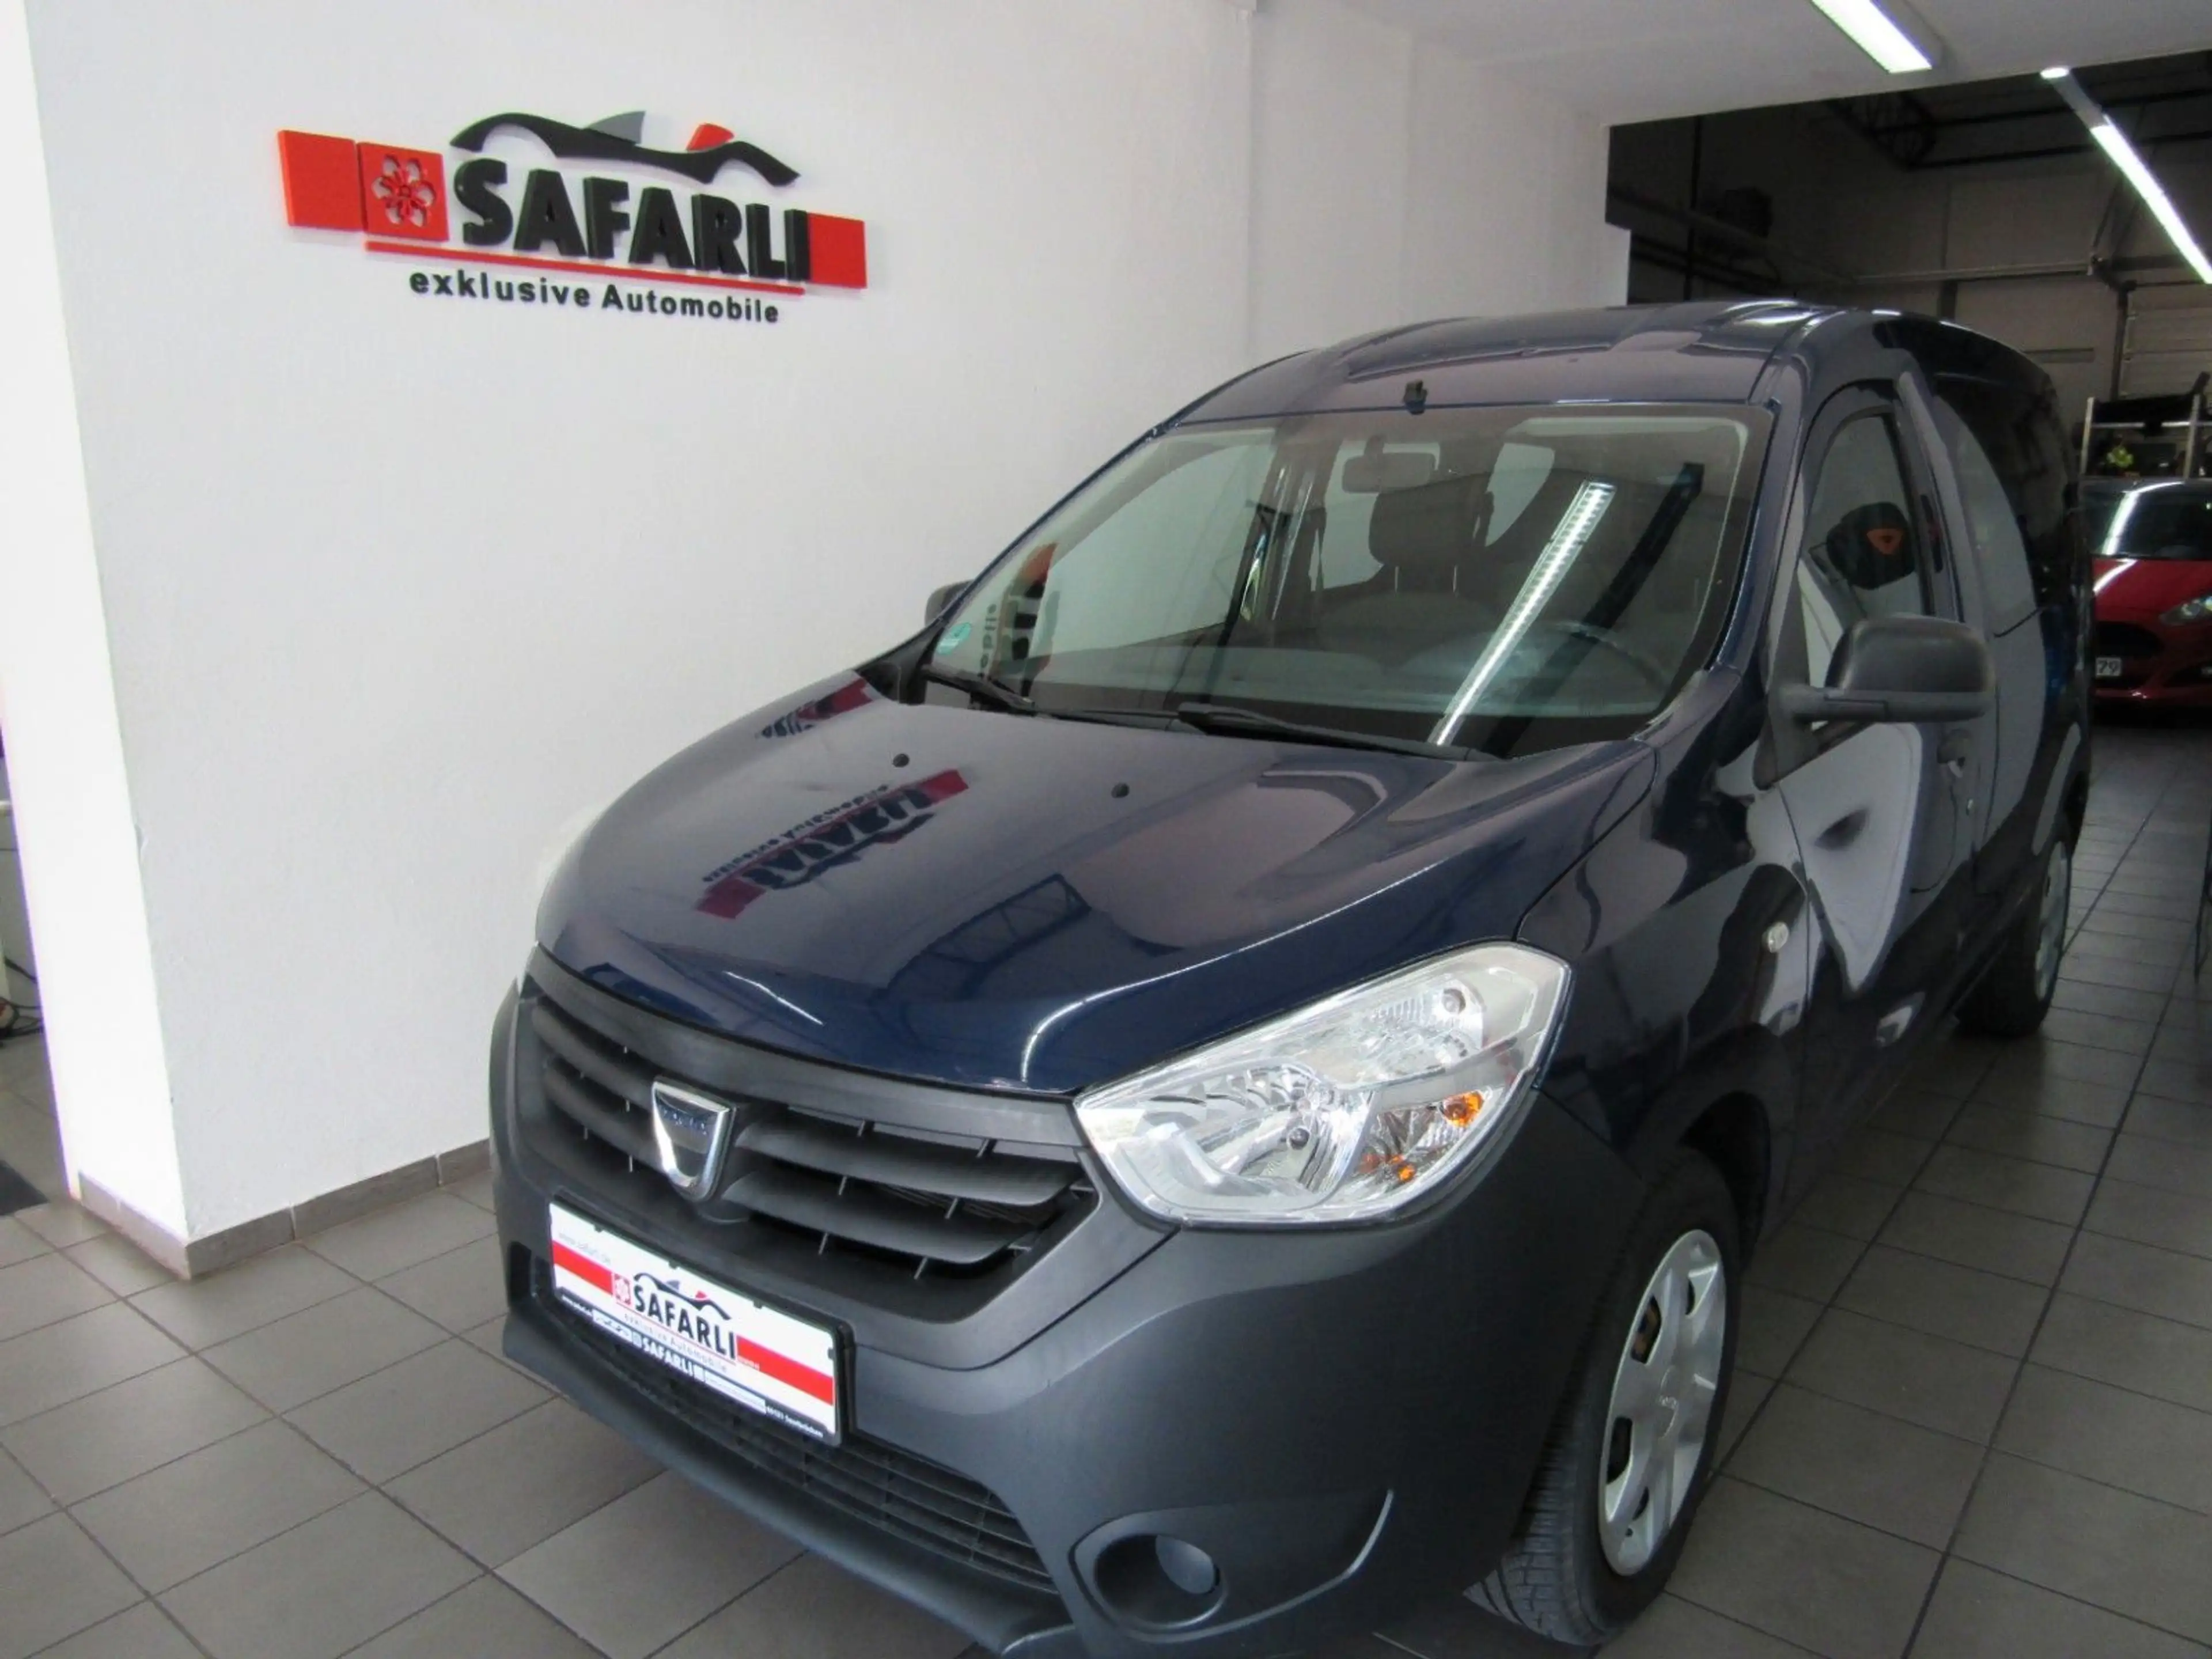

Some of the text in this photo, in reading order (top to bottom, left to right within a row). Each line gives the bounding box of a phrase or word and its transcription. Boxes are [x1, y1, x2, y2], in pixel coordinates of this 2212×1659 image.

[453, 157, 813, 282] SAFARLI
[409, 268, 779, 324] exklusive Automobile
[633, 1284, 736, 1361] SAFARLI
